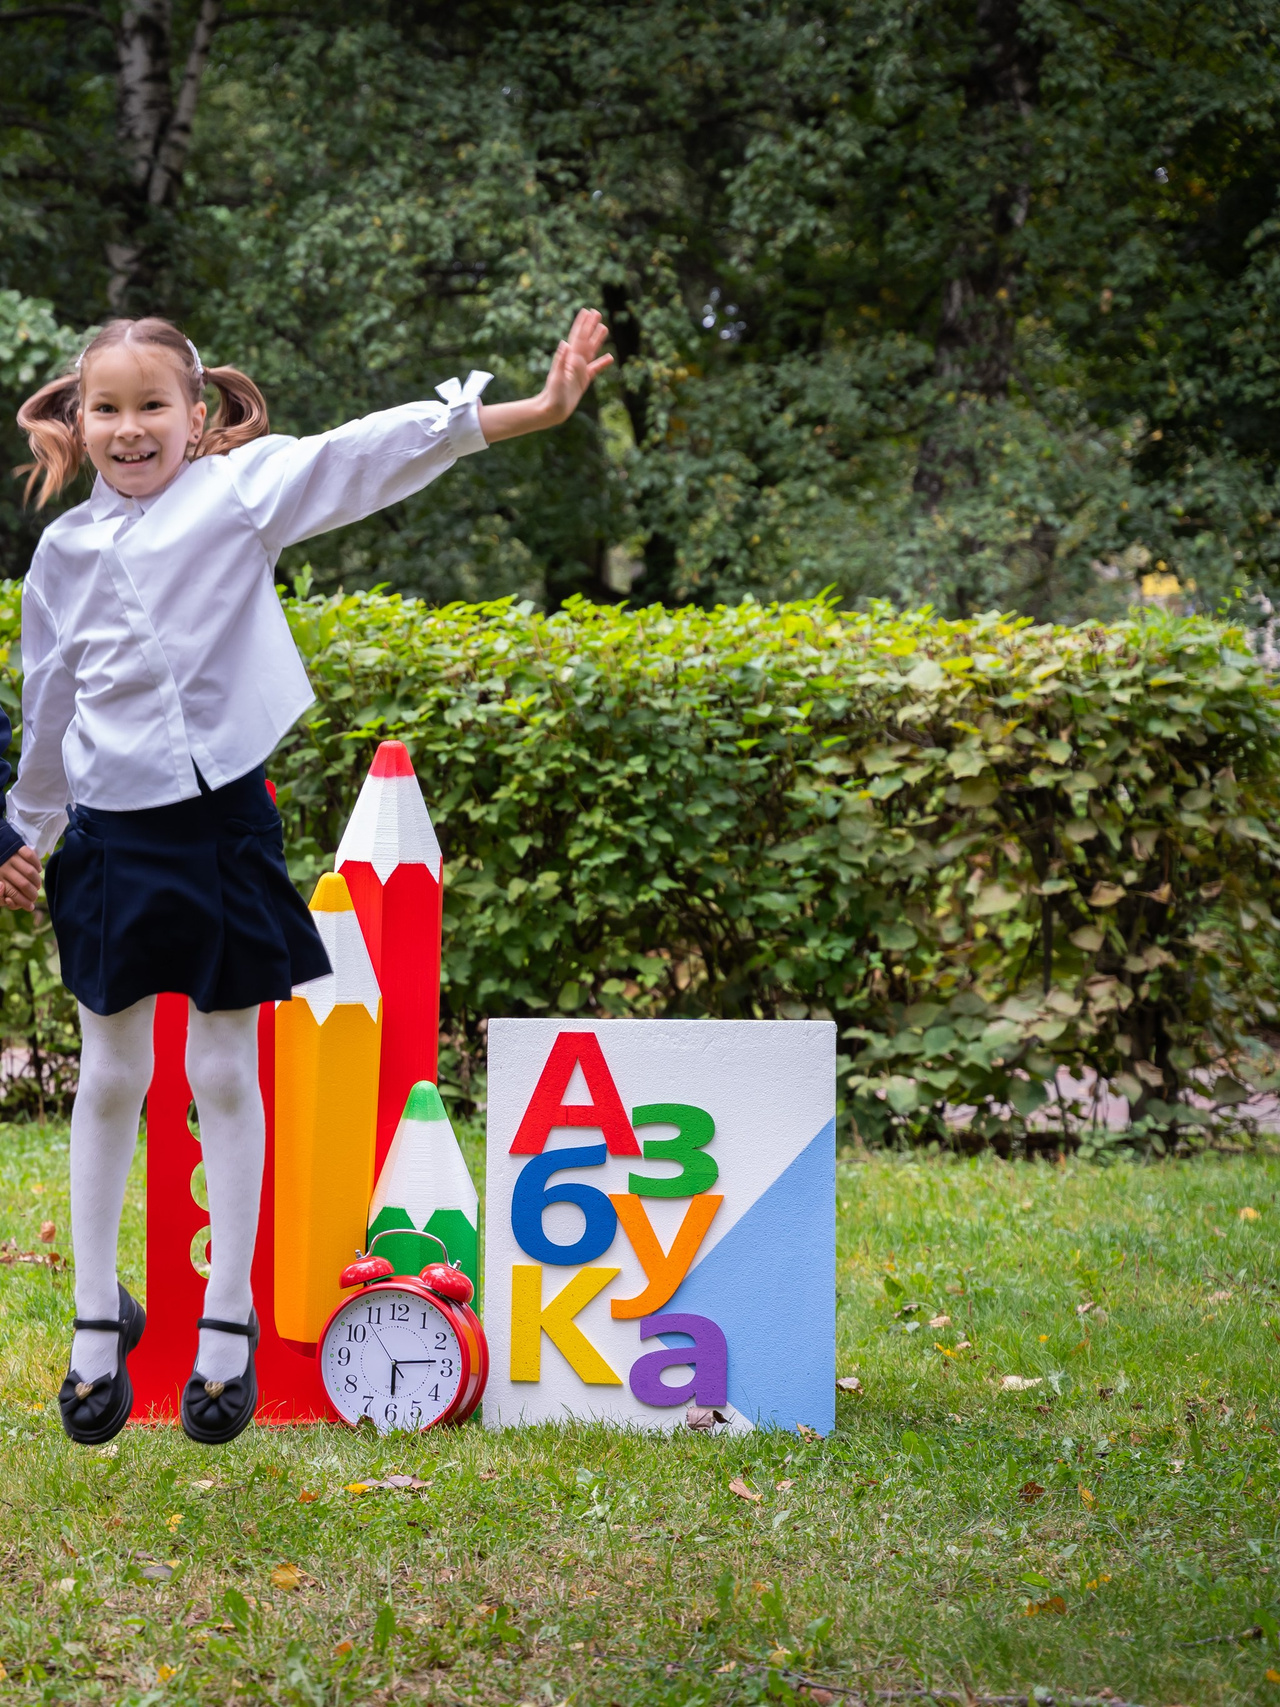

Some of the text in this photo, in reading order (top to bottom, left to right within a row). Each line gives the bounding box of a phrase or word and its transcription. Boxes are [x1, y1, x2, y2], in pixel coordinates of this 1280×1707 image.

[366, 1306, 382, 1325] 11
[389, 1303, 410, 1322] 12
[420, 1311, 428, 1329] 1
[346, 1324, 366, 1343] 10
[434, 1332, 447, 1350] 2
[338, 1347, 351, 1366] 9
[440, 1358, 453, 1377] 3
[344, 1374, 358, 1393] 8
[427, 1383, 440, 1402] 4
[362, 1395, 374, 1413] 7
[384, 1403, 397, 1422] 6
[410, 1400, 422, 1418] 5
